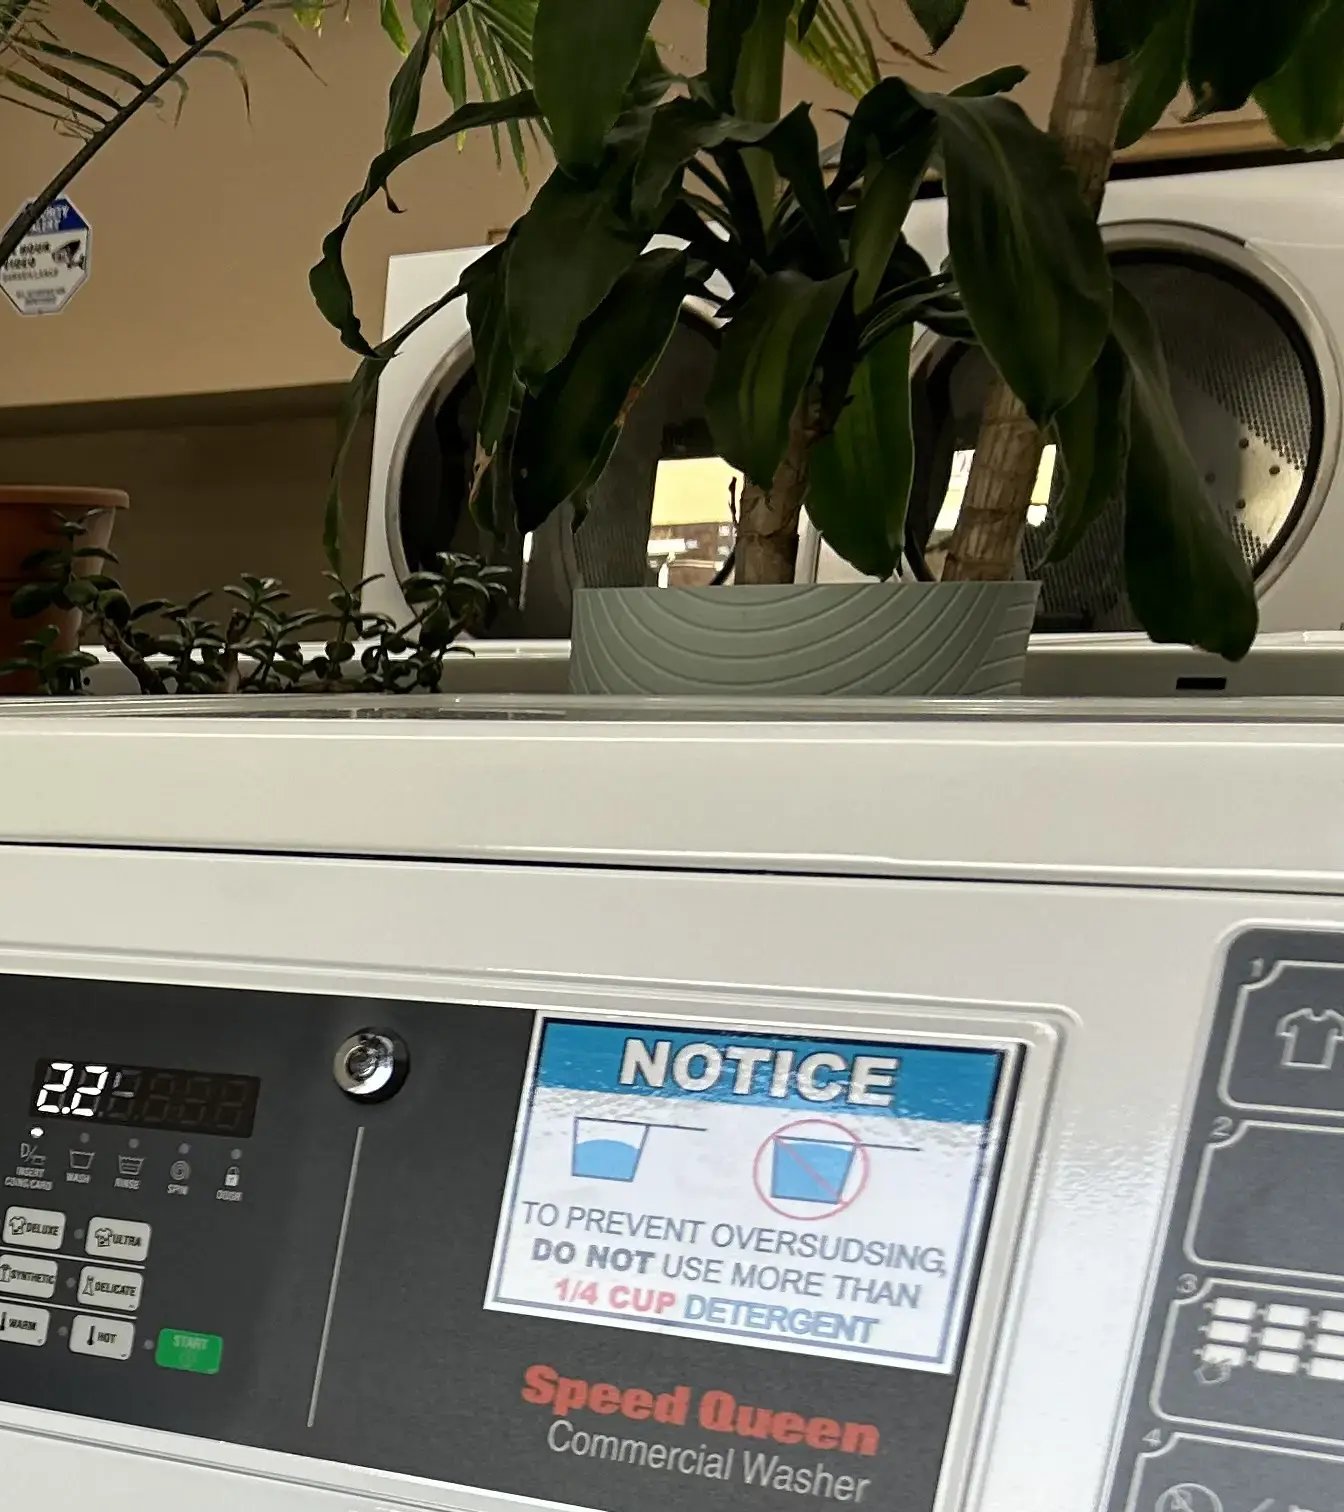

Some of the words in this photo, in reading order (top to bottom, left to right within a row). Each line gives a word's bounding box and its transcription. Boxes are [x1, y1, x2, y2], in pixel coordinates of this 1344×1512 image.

[1249, 958, 1267, 979] 1
[618, 1038, 900, 1108] NOTICE
[1211, 1117, 1233, 1138] 2
[26, 1222, 60, 1237] DELUXE
[521, 1200, 560, 1227] TO
[565, 1207, 705, 1245] PREVENT
[712, 1223, 948, 1279] OVERSUDSING,
[111, 1233, 142, 1248] ULTRA
[11, 1269, 57, 1286] SYNTHETIC
[532, 1238, 576, 1265] DO
[585, 1245, 656, 1275] NOT
[662, 1255, 725, 1284] USE
[730, 1264, 823, 1298] MORE
[831, 1274, 924, 1309] THAN
[1175, 1273, 1198, 1294] 3
[94, 1281, 138, 1298] DELICATE
[554, 1279, 599, 1307] 1/4
[610, 1285, 677, 1314] CUP
[684, 1294, 881, 1345] DETERGENT
[172, 1334, 210, 1351] START
[520, 1363, 692, 1427] Speed
[698, 1388, 881, 1457] Queen
[1142, 1428, 1162, 1447] 4
[546, 1419, 736, 1481] Commercial
[742, 1449, 872, 1503] Washer
